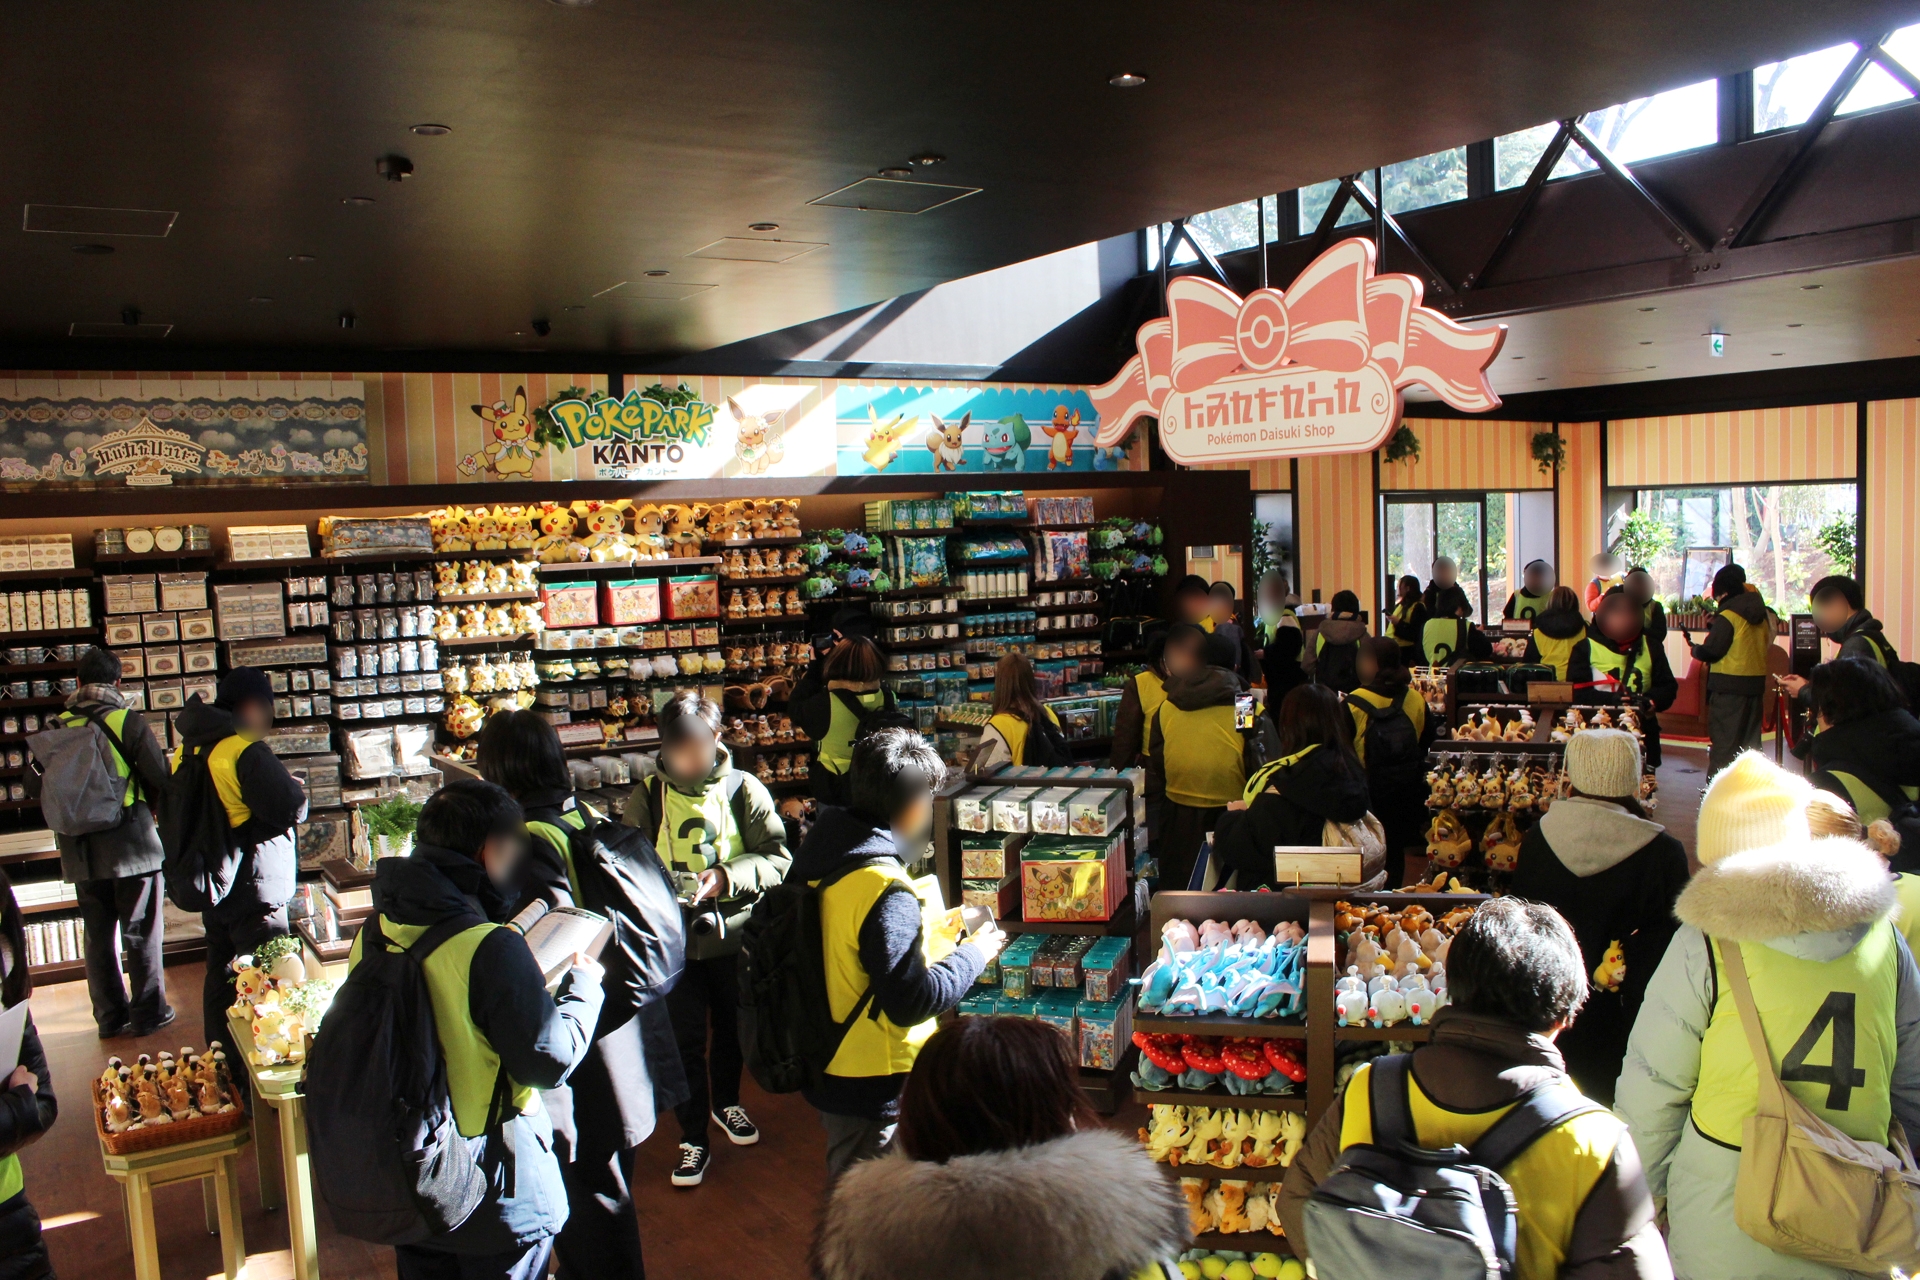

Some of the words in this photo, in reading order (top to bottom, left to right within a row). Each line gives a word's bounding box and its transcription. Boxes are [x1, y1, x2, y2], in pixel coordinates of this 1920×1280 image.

[1207, 431, 1257, 446] Pokémon
[1260, 425, 1301, 441] Daisuki
[1304, 424, 1335, 438] Shop
[593, 444, 684, 464] KANTO
[599, 467, 640, 478] ポケパーク
[647, 468, 678, 476] カントー
[670, 817, 720, 874] 3
[1780, 991, 1866, 1111] 4
